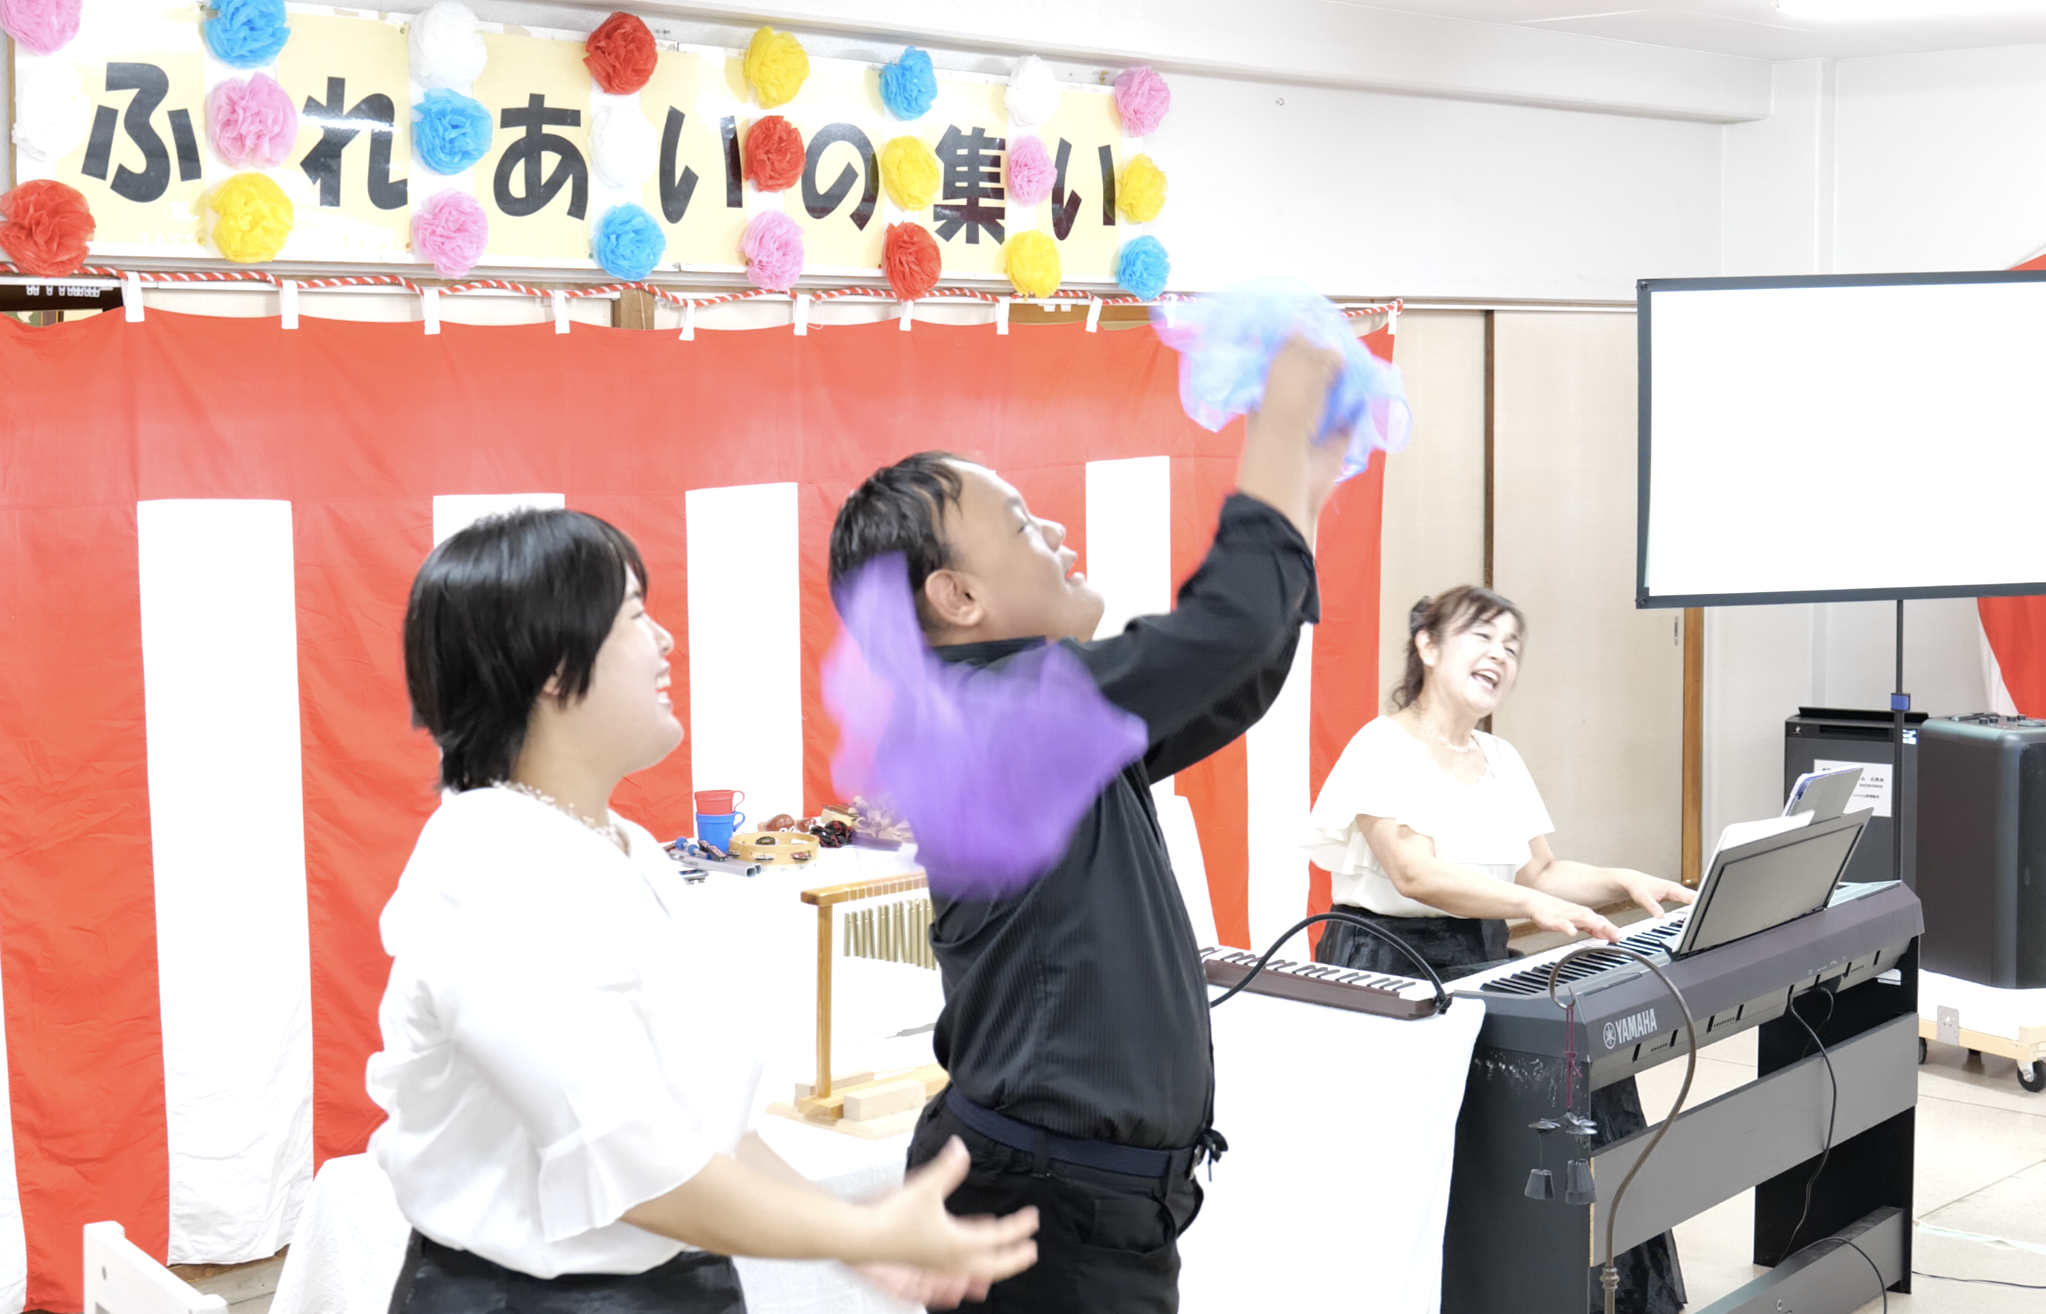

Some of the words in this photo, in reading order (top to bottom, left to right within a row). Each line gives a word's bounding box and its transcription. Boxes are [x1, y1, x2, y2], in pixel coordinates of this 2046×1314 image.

[81, 62, 1116, 245] ふれあいの集い
[1615, 1008, 1657, 1044] YAMAHA
